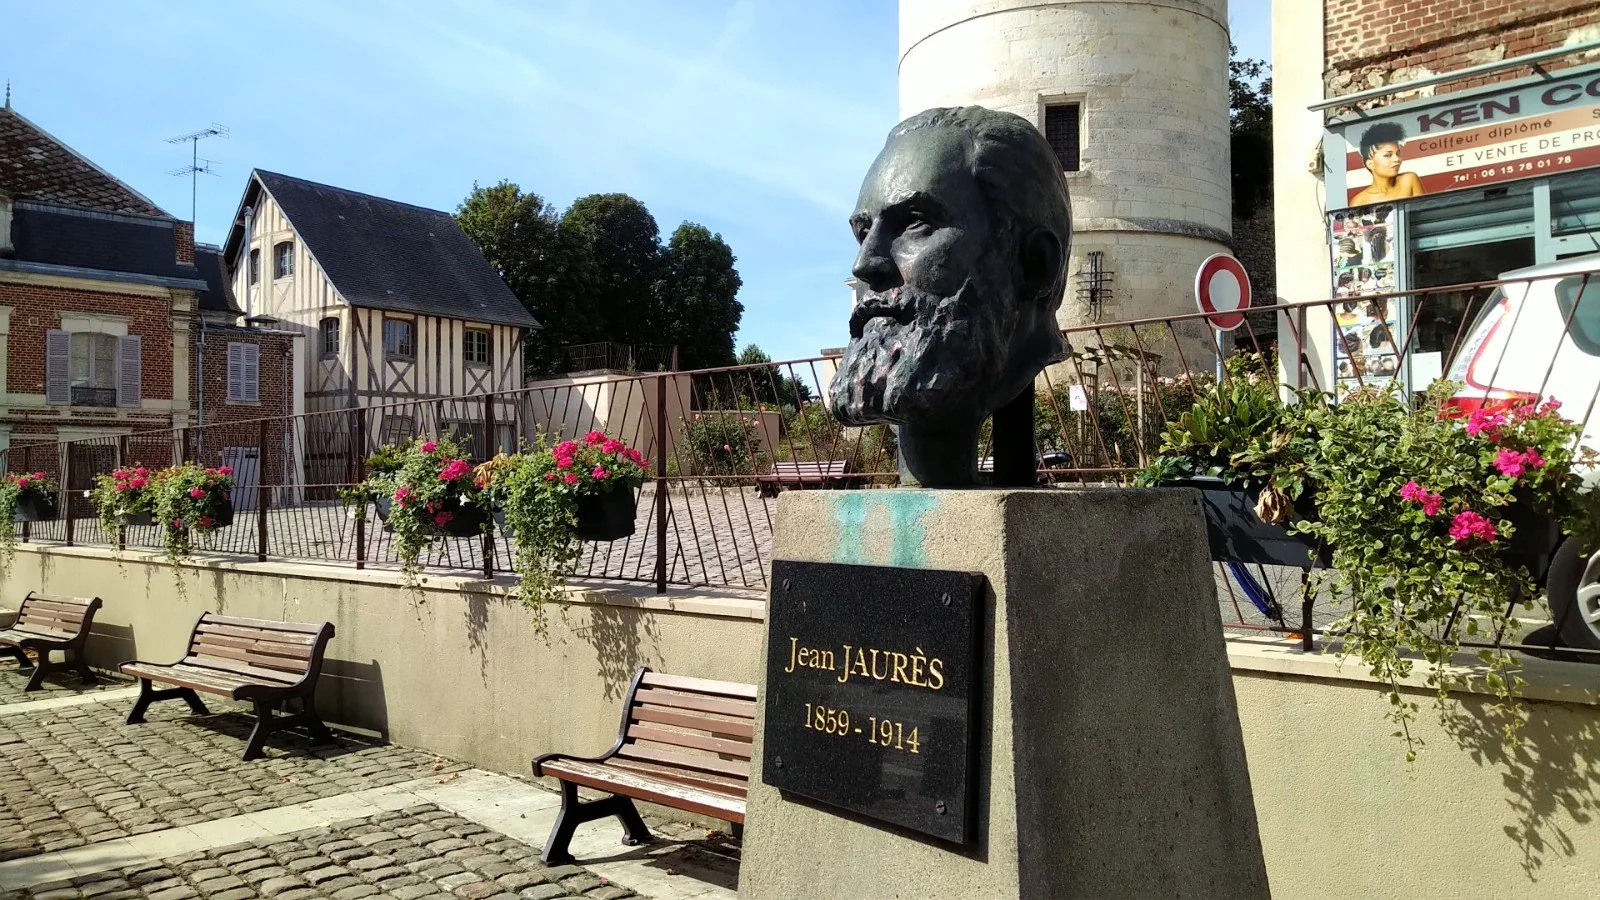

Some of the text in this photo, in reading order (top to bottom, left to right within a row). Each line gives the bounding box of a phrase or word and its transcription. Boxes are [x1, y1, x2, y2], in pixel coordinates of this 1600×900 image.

[1417, 95, 1520, 132] KEN
[1419, 133, 1480, 152] Coiffeur
[1488, 118, 1552, 138] diplômé
[1446, 154, 1465, 167] ET
[1474, 142, 1528, 161] VENTE
[1539, 136, 1561, 150] DE
[1481, 169, 1496, 178] 06
[1500, 166, 1514, 174] 15
[1519, 162, 1533, 171] 78
[1537, 159, 1551, 168] 01
[1558, 155, 1572, 165] 78
[785, 637, 944, 690] Jean JAURÈS
[804, 703, 850, 736] 1859
[868, 716, 920, 754] 1914
